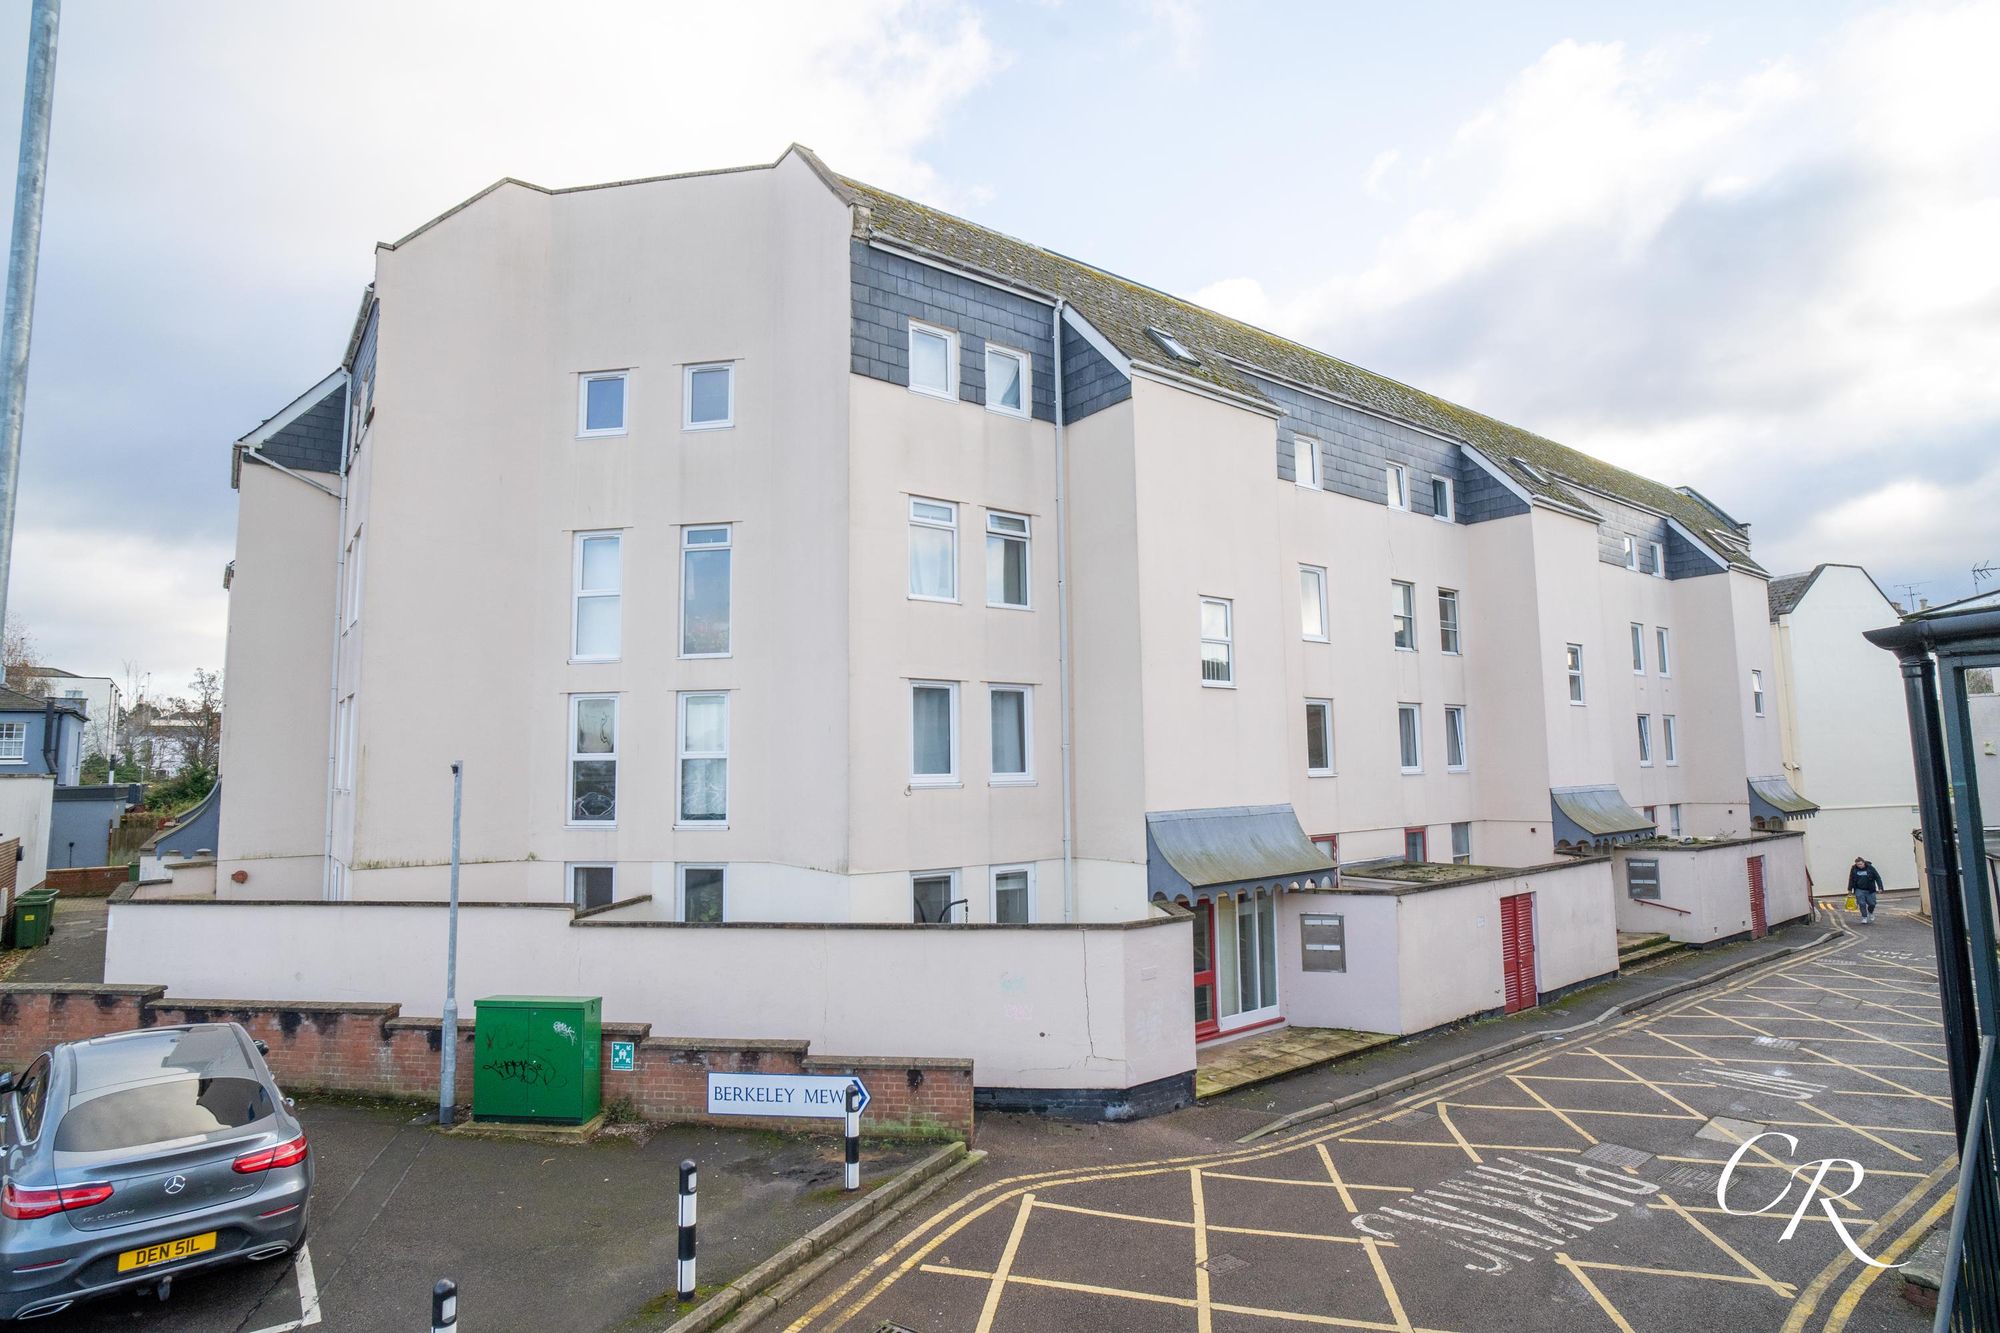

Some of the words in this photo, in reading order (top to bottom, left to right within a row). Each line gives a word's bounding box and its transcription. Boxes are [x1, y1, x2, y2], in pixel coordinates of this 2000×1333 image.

[714, 1086, 795, 1103] BERKELEY
[804, 1089, 847, 1104] MEW
[1351, 1151, 1661, 1276] PARKING
[135, 1245, 170, 1265] DEN
